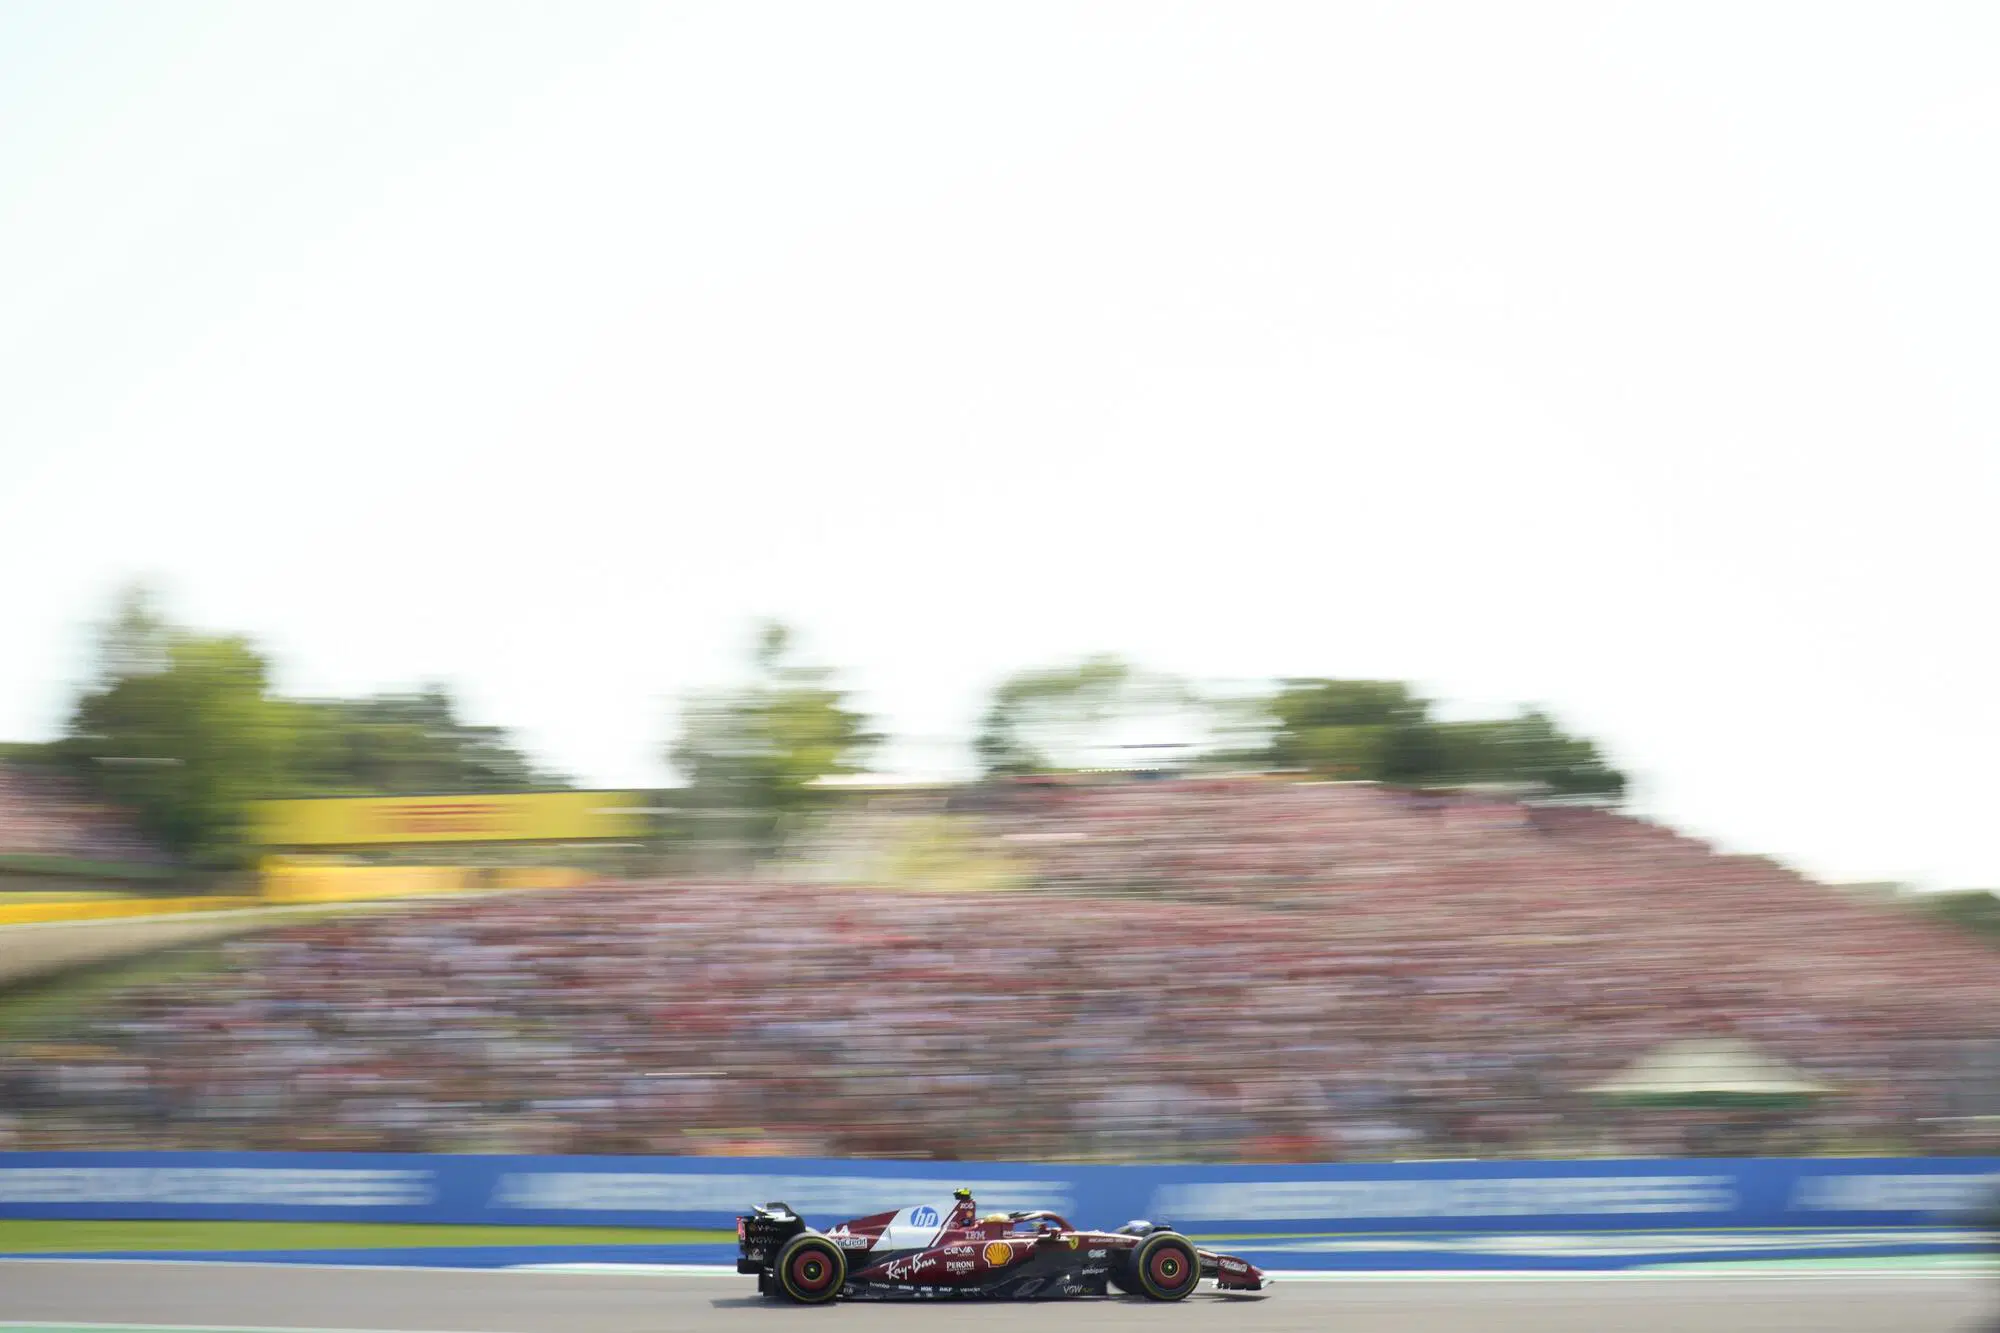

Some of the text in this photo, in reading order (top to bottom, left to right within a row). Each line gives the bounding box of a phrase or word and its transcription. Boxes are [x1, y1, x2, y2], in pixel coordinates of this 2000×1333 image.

[913, 1206, 937, 1228] hp
[964, 1231, 985, 1241] IBM
[836, 1238, 867, 1247] niCredit
[946, 1261, 975, 1269] PERONI
